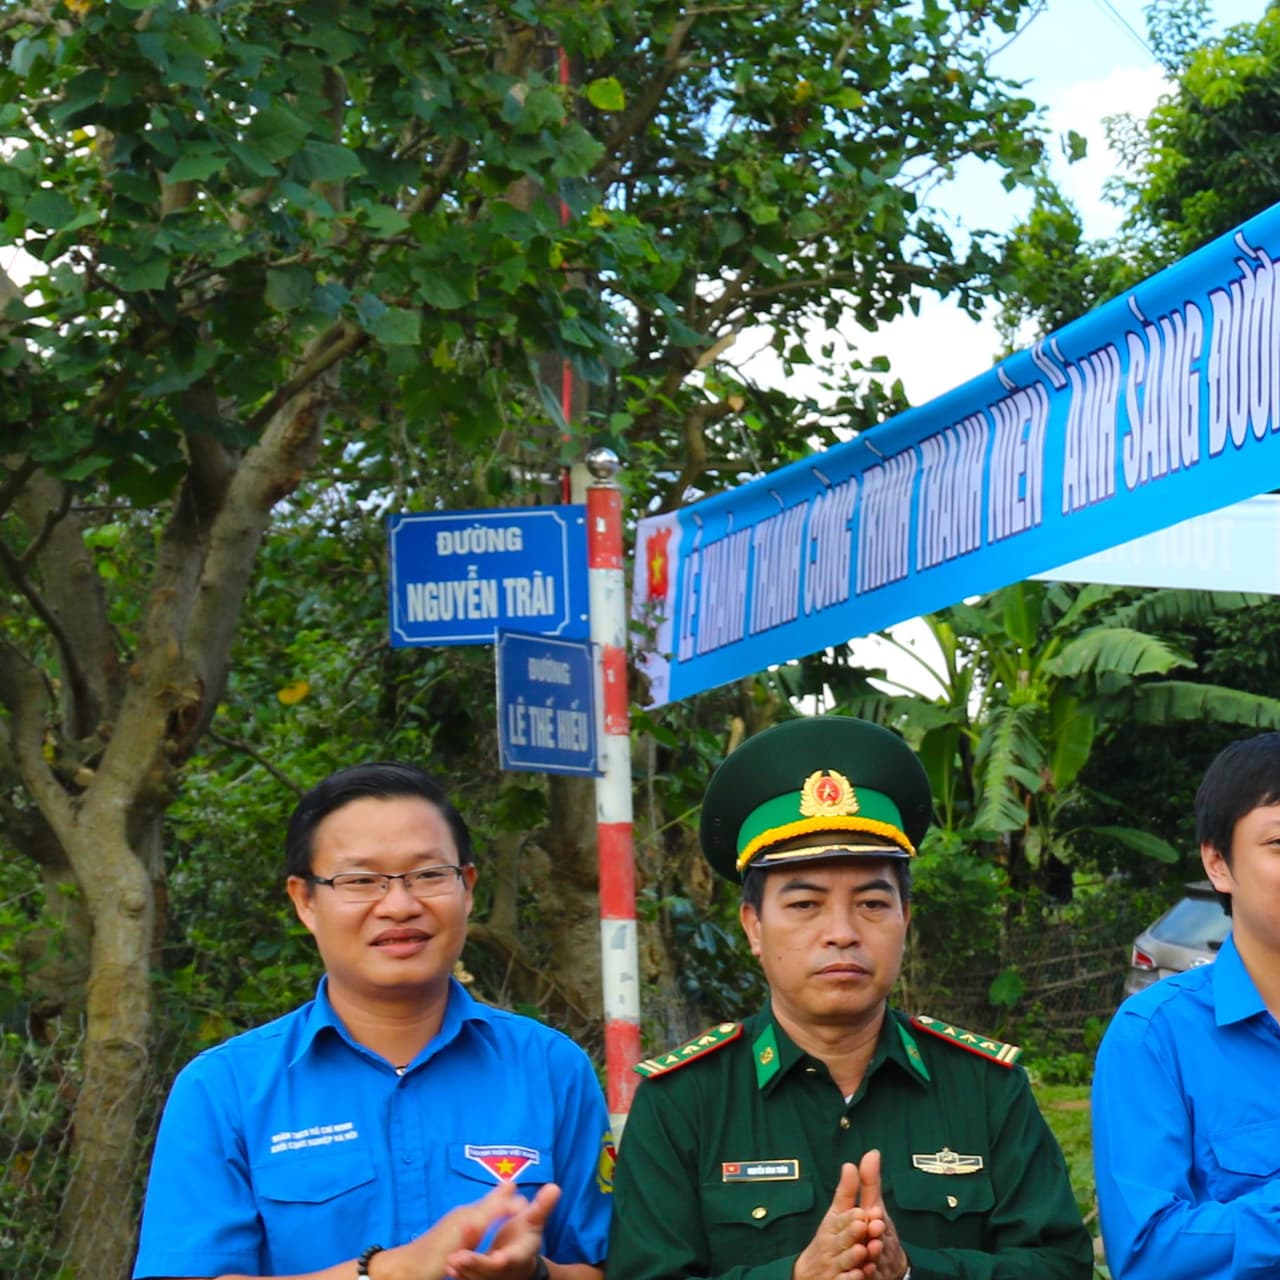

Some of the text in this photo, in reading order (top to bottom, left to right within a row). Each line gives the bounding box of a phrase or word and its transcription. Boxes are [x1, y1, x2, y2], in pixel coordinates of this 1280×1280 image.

[749, 489, 808, 637] THÀNH
[804, 466, 858, 617] CÔNG
[856, 439, 916, 596] TRÌNH
[916, 412, 990, 573] THANH
[987, 367, 1049, 545] NIÊN
[1123, 293, 1204, 490] SÁNG
[436, 523, 523, 556] ĐƯỜNG
[407, 564, 555, 622] NGUYỄN TRÃI
[508, 696, 527, 745] LÊ
